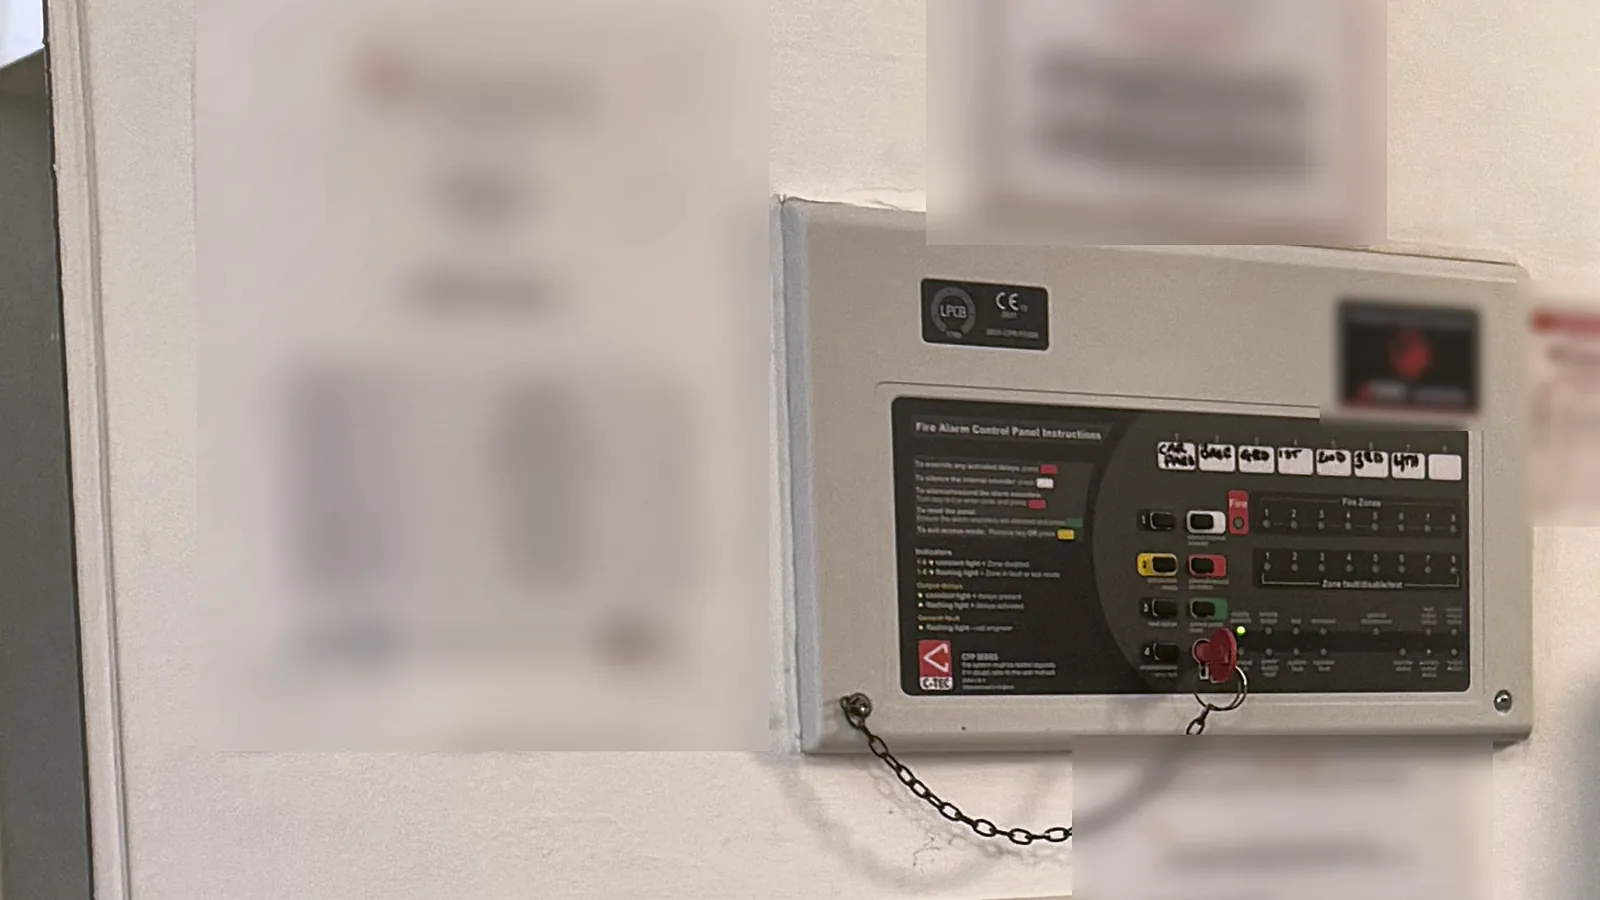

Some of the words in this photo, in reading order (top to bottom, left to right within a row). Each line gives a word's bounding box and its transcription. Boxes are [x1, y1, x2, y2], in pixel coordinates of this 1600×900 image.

[995, 291, 1019, 311] CE
[939, 304, 967, 318] LPCB
[915, 421, 936, 433] Fire
[938, 422, 970, 434] Alarm
[972, 424, 1010, 436] Control
[1012, 426, 1040, 438] Panel
[1042, 427, 1102, 440] Instructions
[1355, 451, 1384, 469] 3RD
[1229, 499, 1248, 509] Fire
[1342, 497, 1357, 507] Fire
[1358, 498, 1381, 507] Zones
[1322, 579, 1341, 588] Zone
[922, 677, 951, 690] C-TEC
